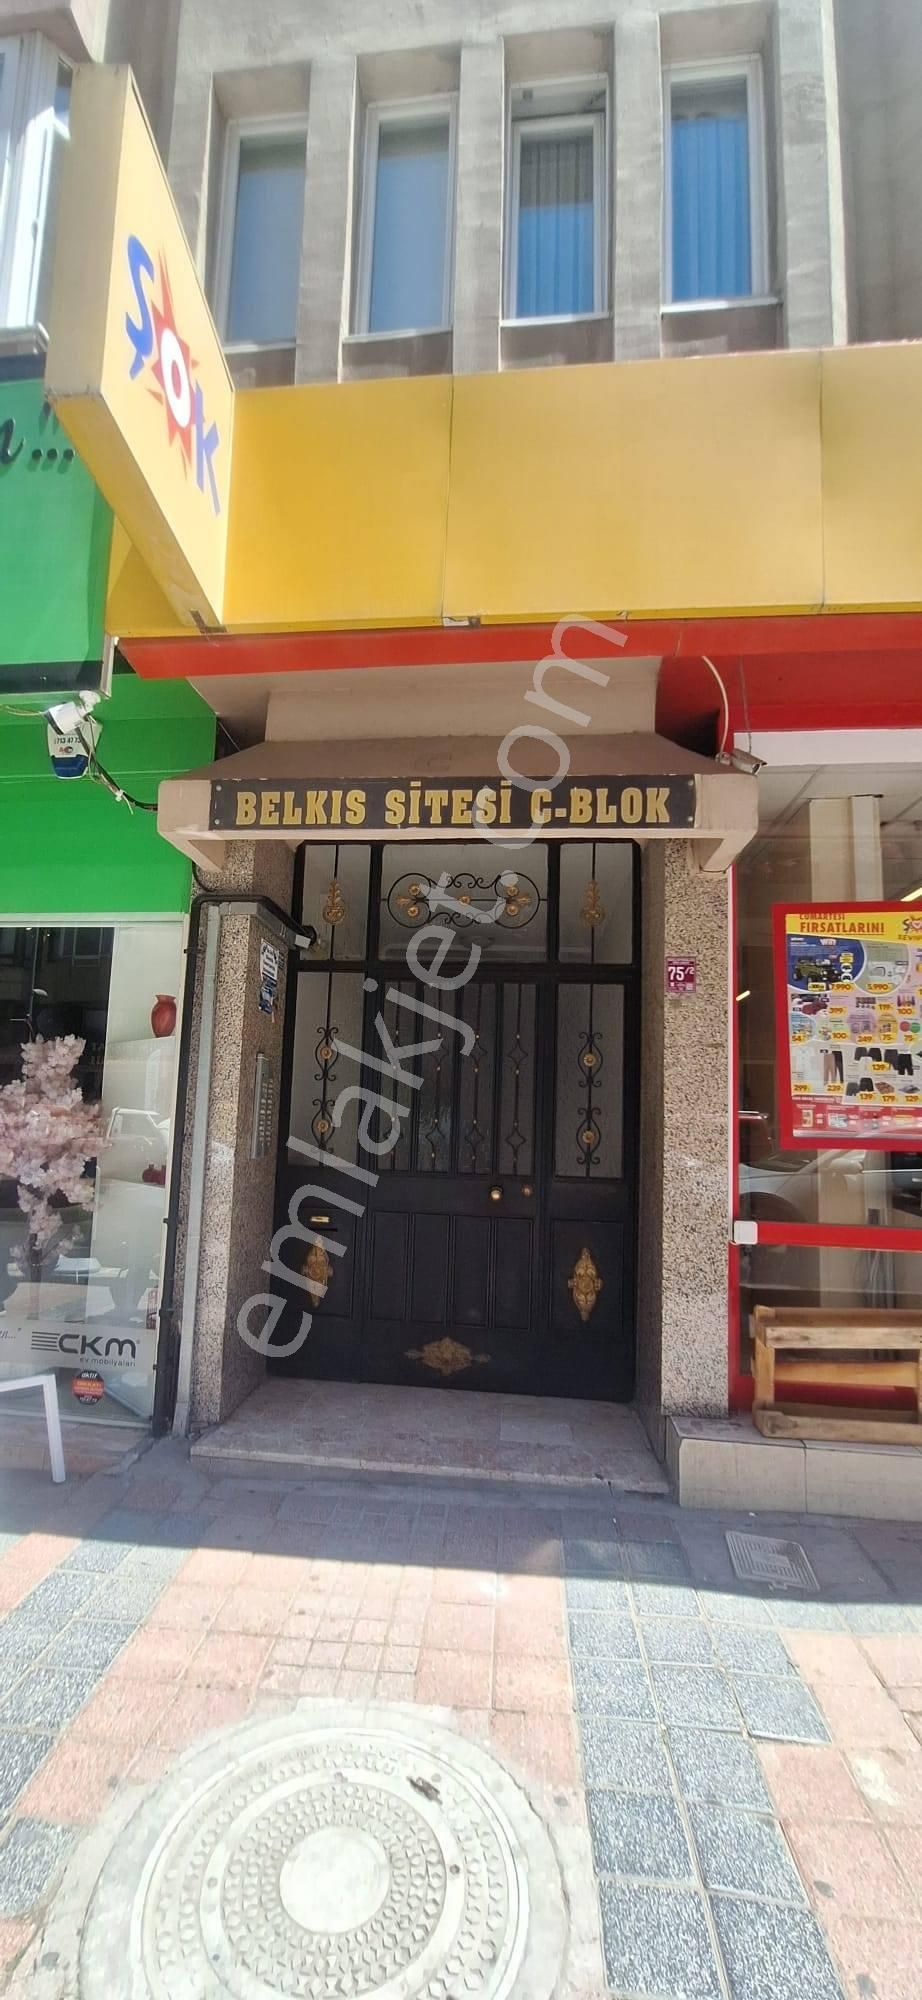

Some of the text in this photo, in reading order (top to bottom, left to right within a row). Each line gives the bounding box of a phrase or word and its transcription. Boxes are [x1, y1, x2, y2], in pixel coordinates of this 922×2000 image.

[125, 234, 220, 516] ŞOK
[235, 781, 671, 826] BELKIS SİTESİ C-BLOK
[800, 922, 885, 933] FIRSATLARINI
